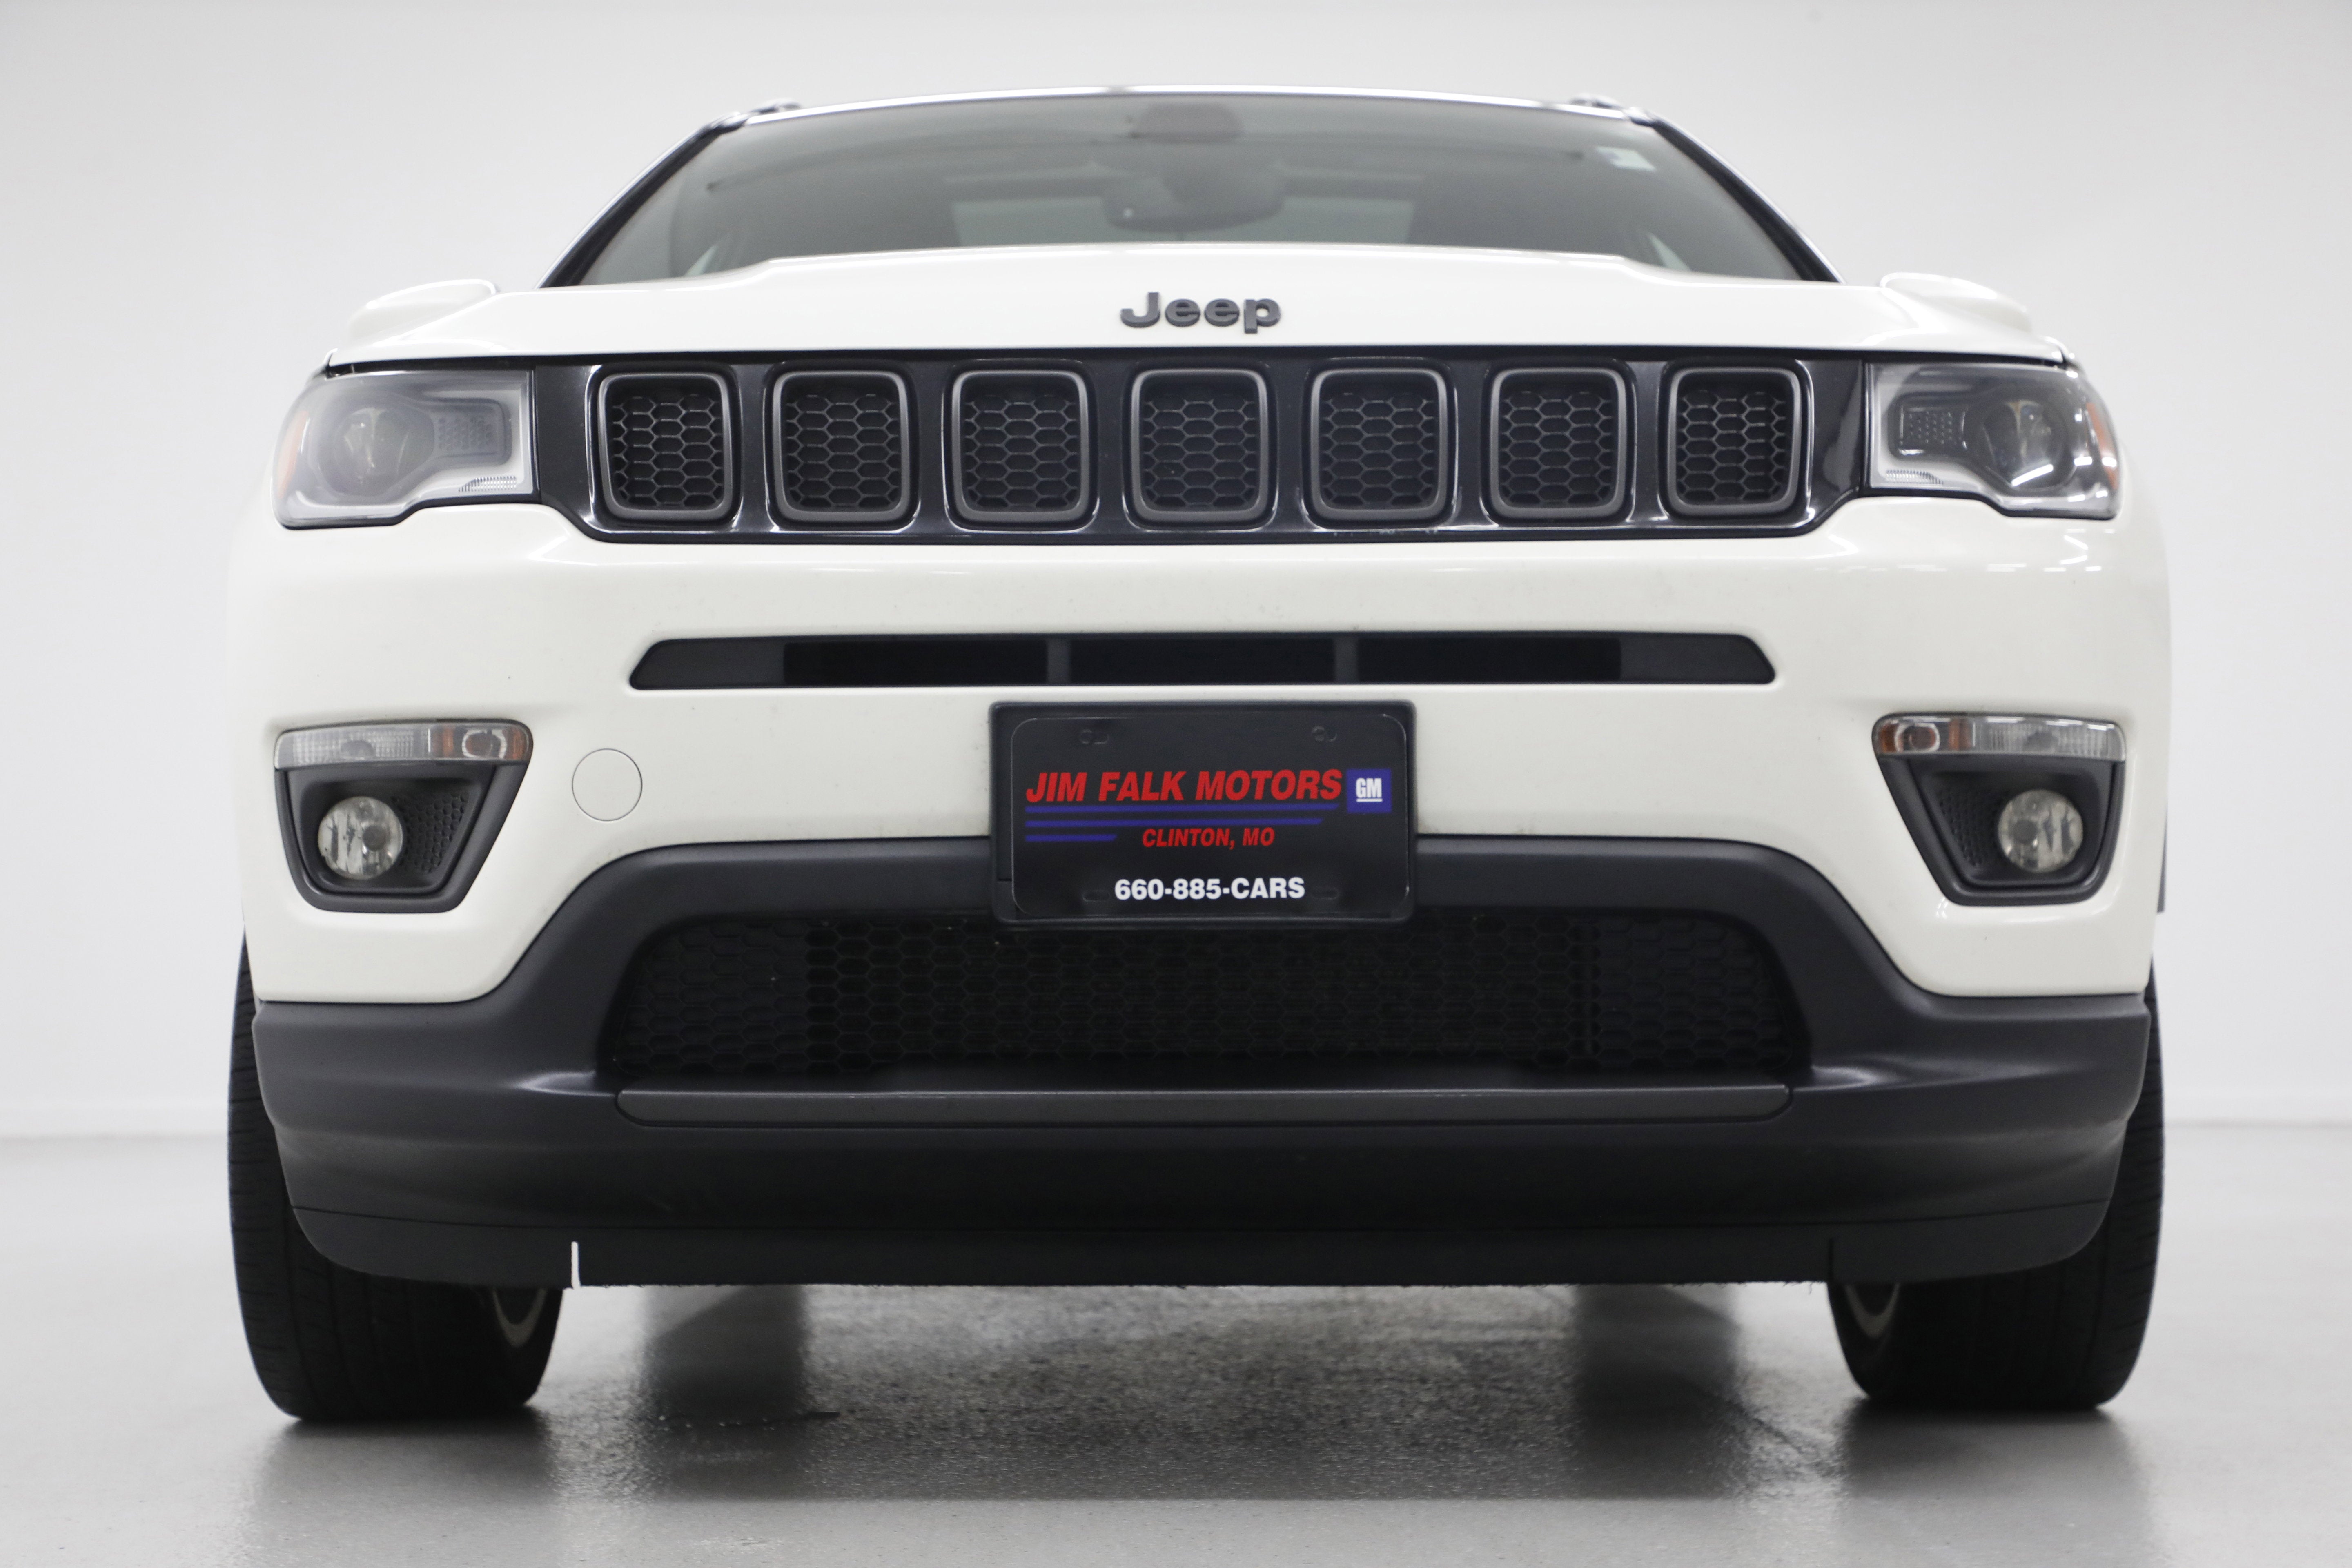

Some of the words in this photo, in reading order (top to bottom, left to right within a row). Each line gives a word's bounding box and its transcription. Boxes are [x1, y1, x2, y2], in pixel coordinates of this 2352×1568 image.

[1120, 292, 1281, 334] Jeep
[1025, 772, 1087, 803] JIM
[1098, 771, 1187, 802] FALK
[1195, 768, 1342, 801] MOTORS
[1355, 777, 1383, 798] GM
[1142, 828, 1235, 849] CLINTON,
[1242, 827, 1275, 846] MO
[1114, 877, 1305, 900] 660-885-CARS
